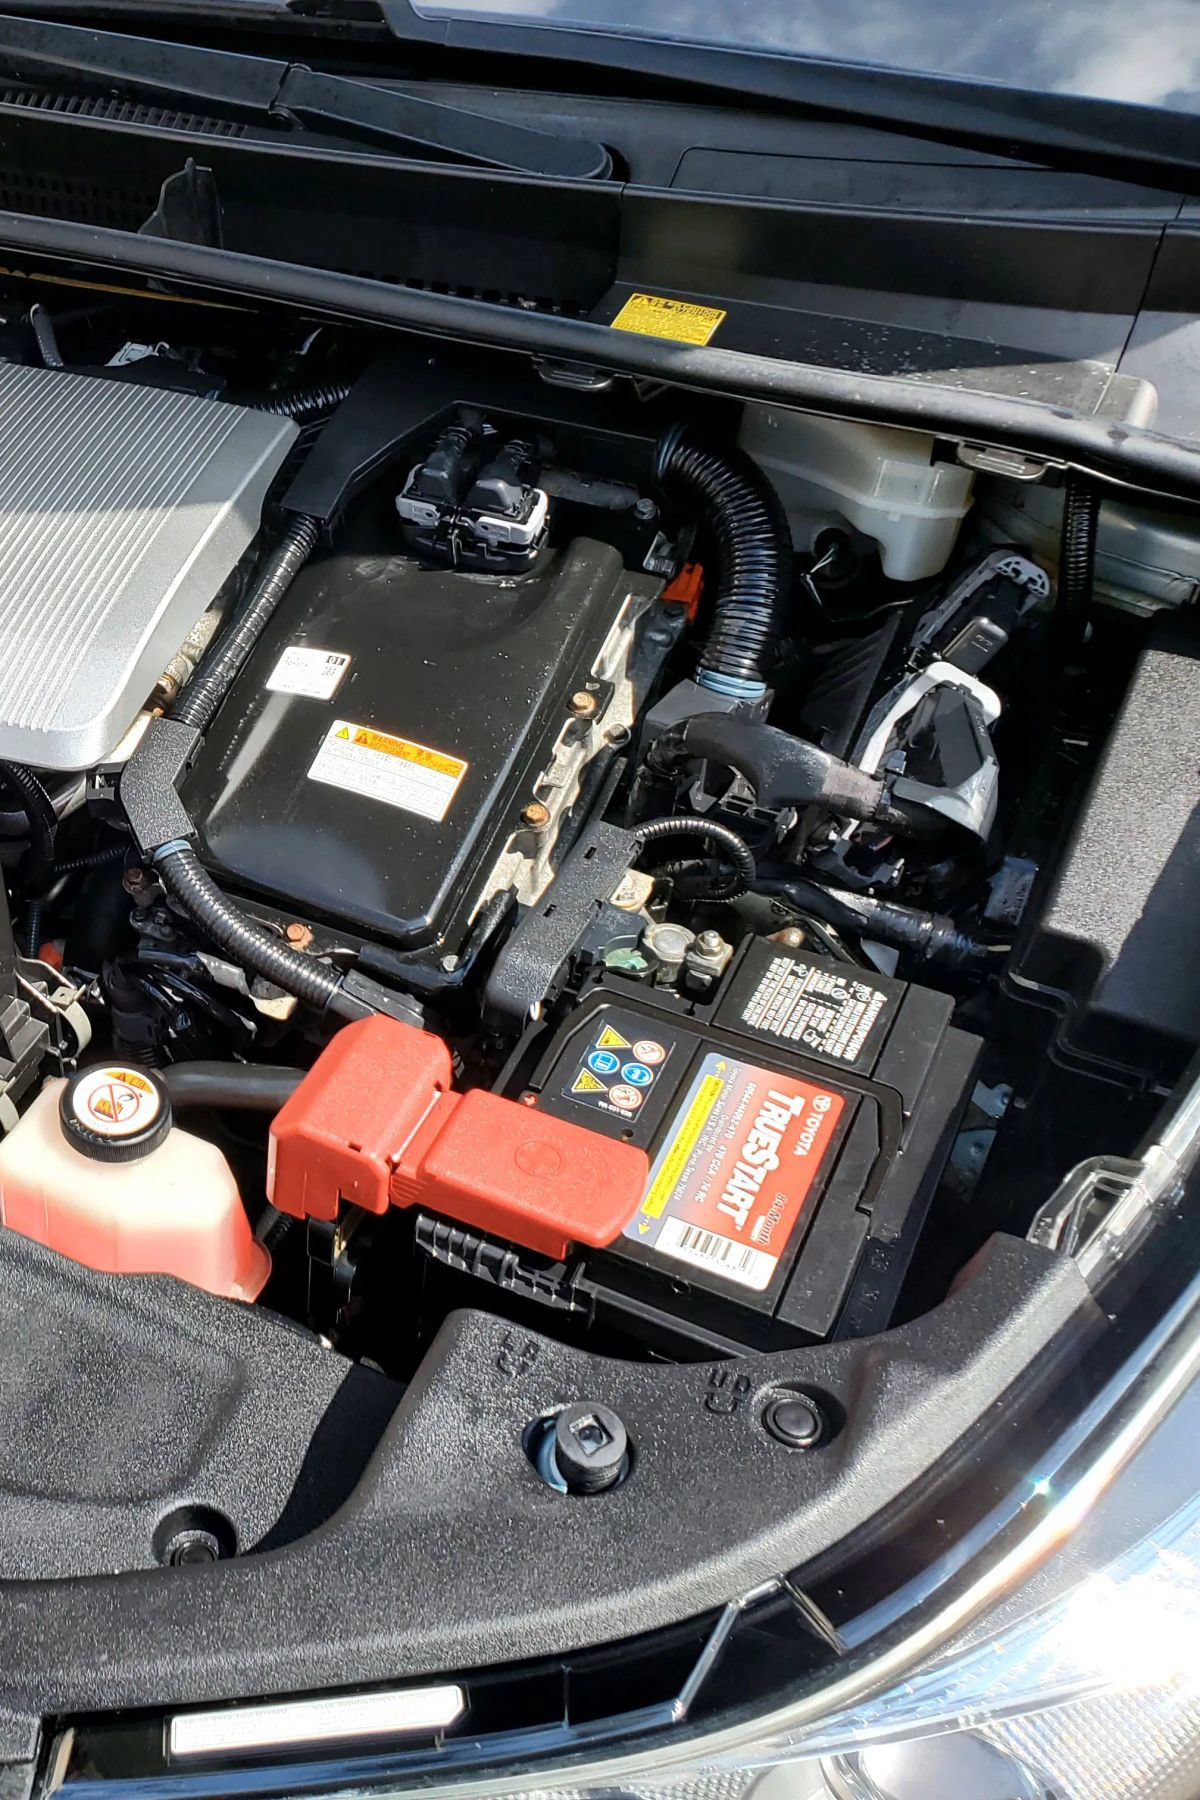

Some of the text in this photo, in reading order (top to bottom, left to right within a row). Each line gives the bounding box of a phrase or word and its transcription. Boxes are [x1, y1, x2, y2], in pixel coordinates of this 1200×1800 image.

[840, 998, 884, 1061] DANGER/POISON
[793, 1111, 823, 1156] TOYOTA
[713, 1143, 728, 1159] 470
[706, 1158, 721, 1176] CCA
[693, 1190, 706, 1203] RC
